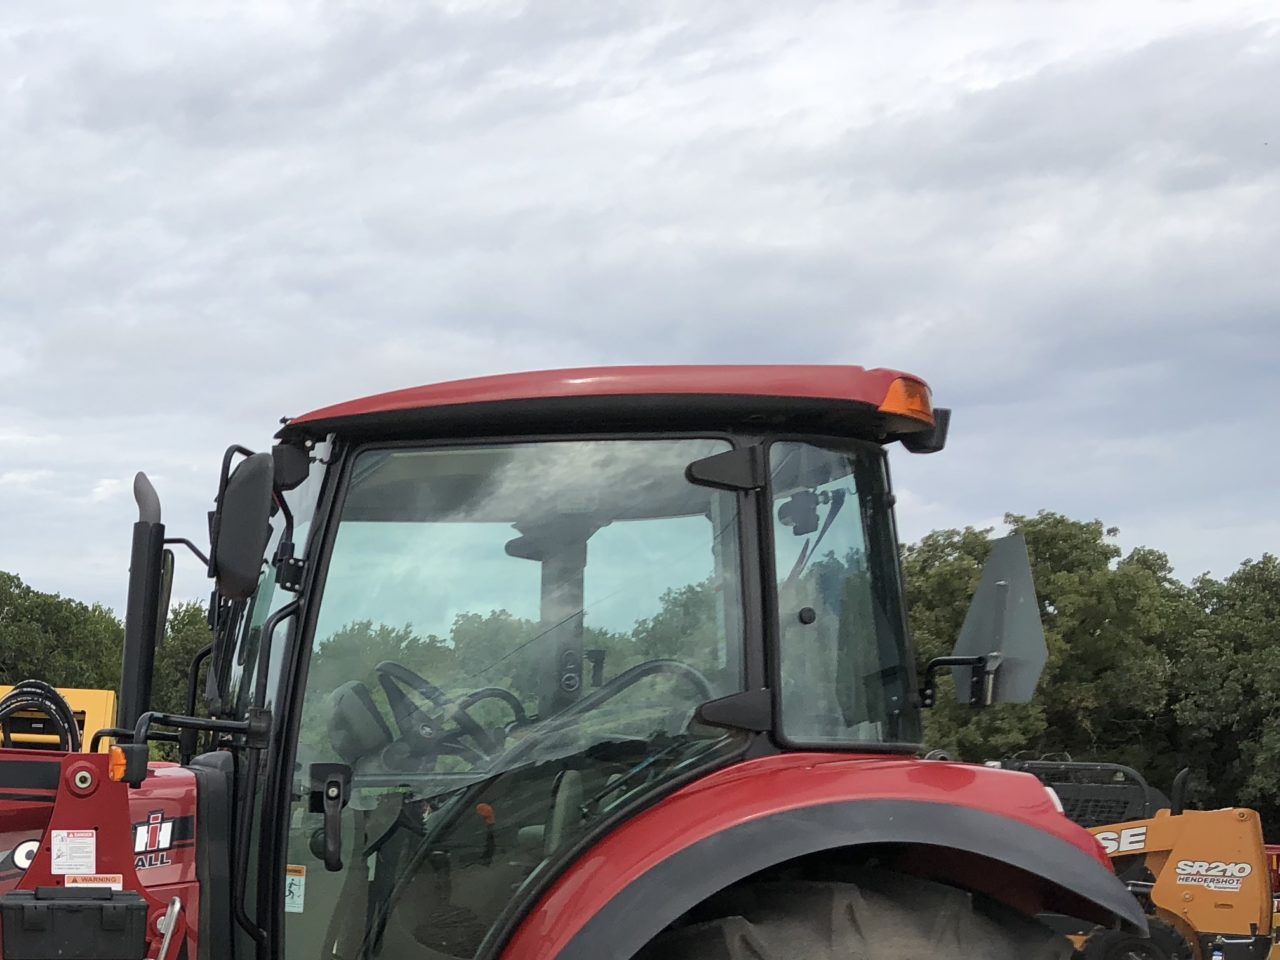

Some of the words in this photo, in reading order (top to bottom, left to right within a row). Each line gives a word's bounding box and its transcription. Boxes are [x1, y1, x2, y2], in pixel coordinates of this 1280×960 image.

[1095, 826, 1147, 854] SE
[134, 851, 171, 870] ALL
[1175, 860, 1252, 877] SR210
[1178, 876, 1240, 885] HENDERSHOT
